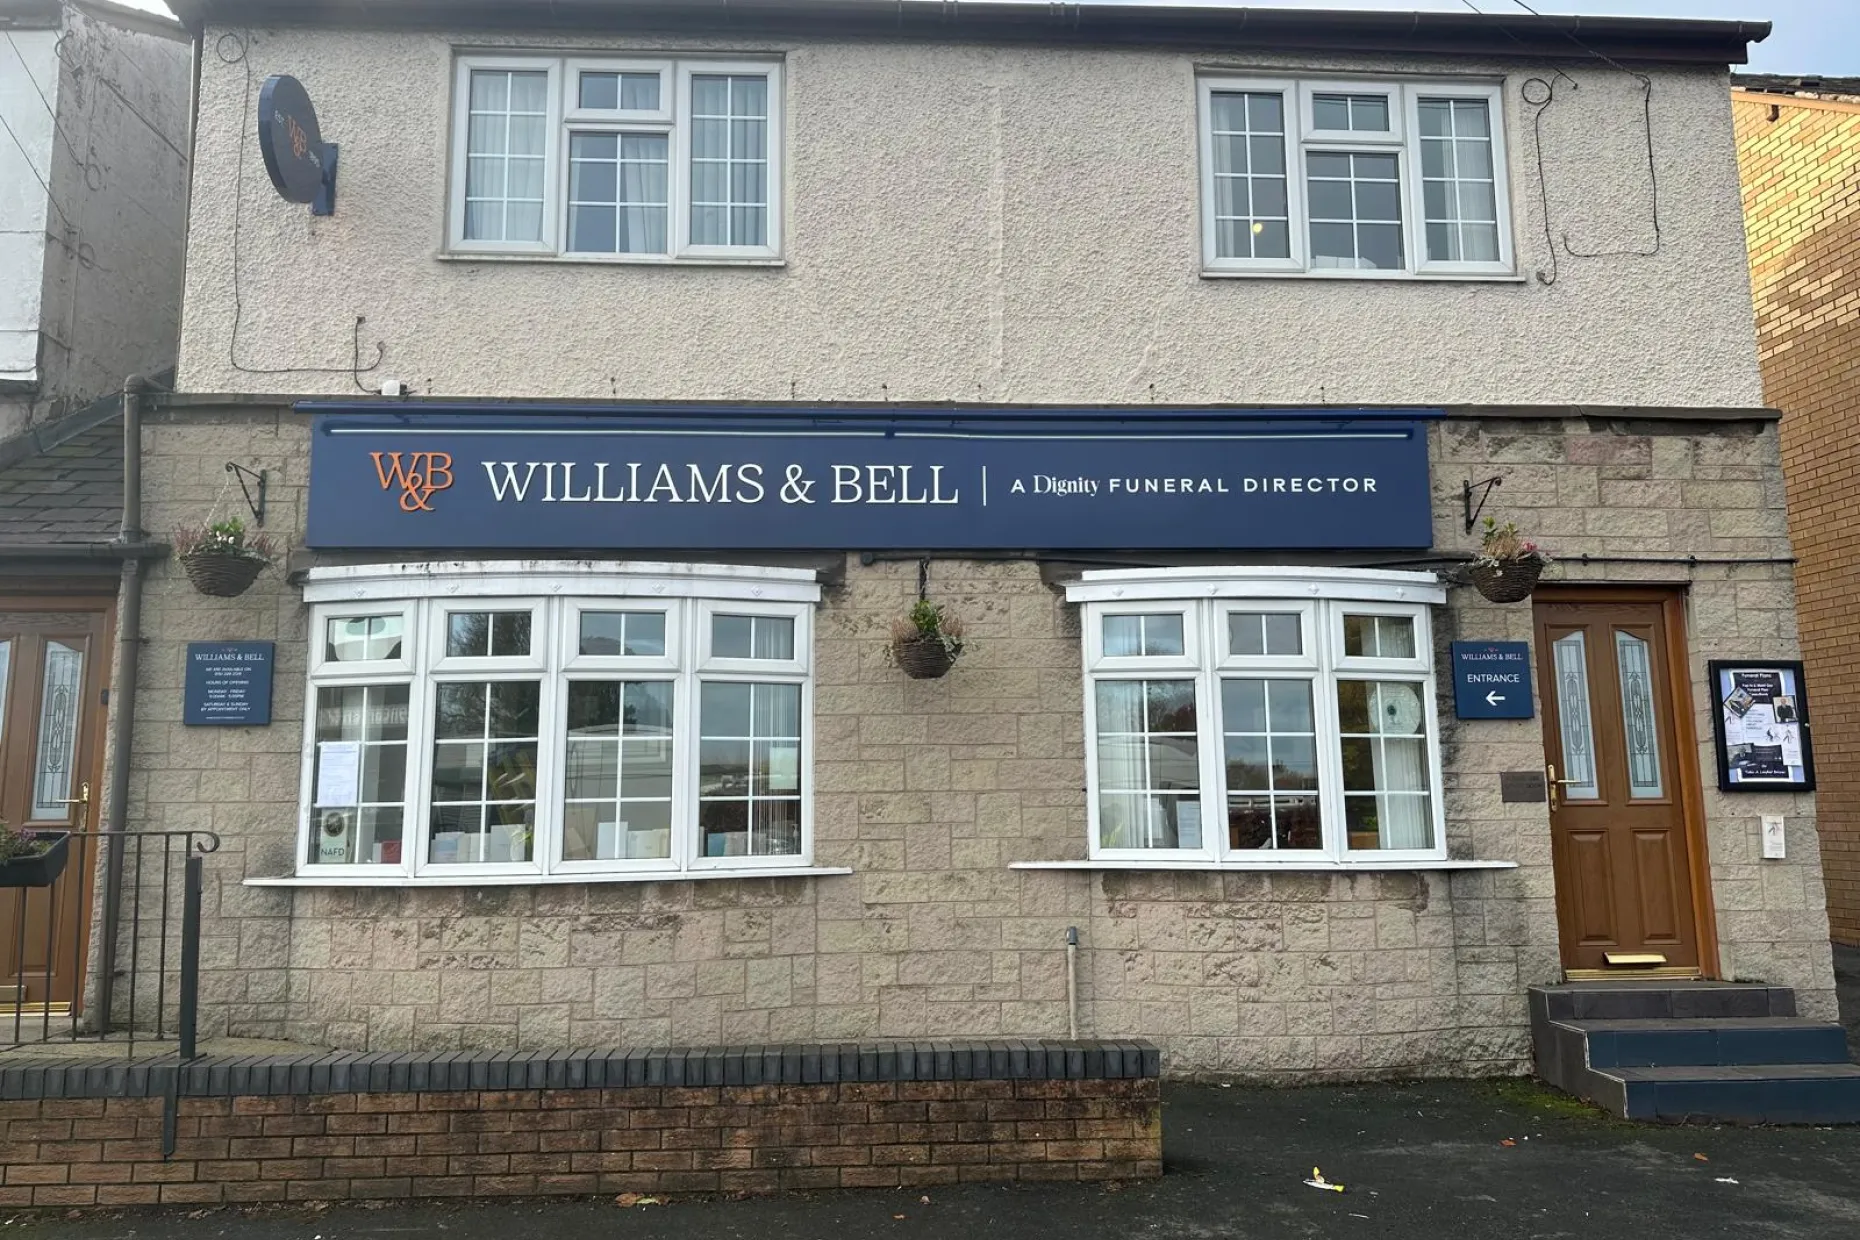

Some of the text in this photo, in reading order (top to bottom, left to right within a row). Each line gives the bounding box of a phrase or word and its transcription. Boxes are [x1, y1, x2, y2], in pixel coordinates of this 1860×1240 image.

[480, 461, 960, 505] WILLIAMS & BELL
[1010, 474, 1378, 497] A Dignity FUNERAL DIRECTOR
[195, 653, 265, 661] WILLIAMS & BELL
[1467, 673, 1520, 683] ENTRANCE
[320, 847, 345, 857] NAFD
